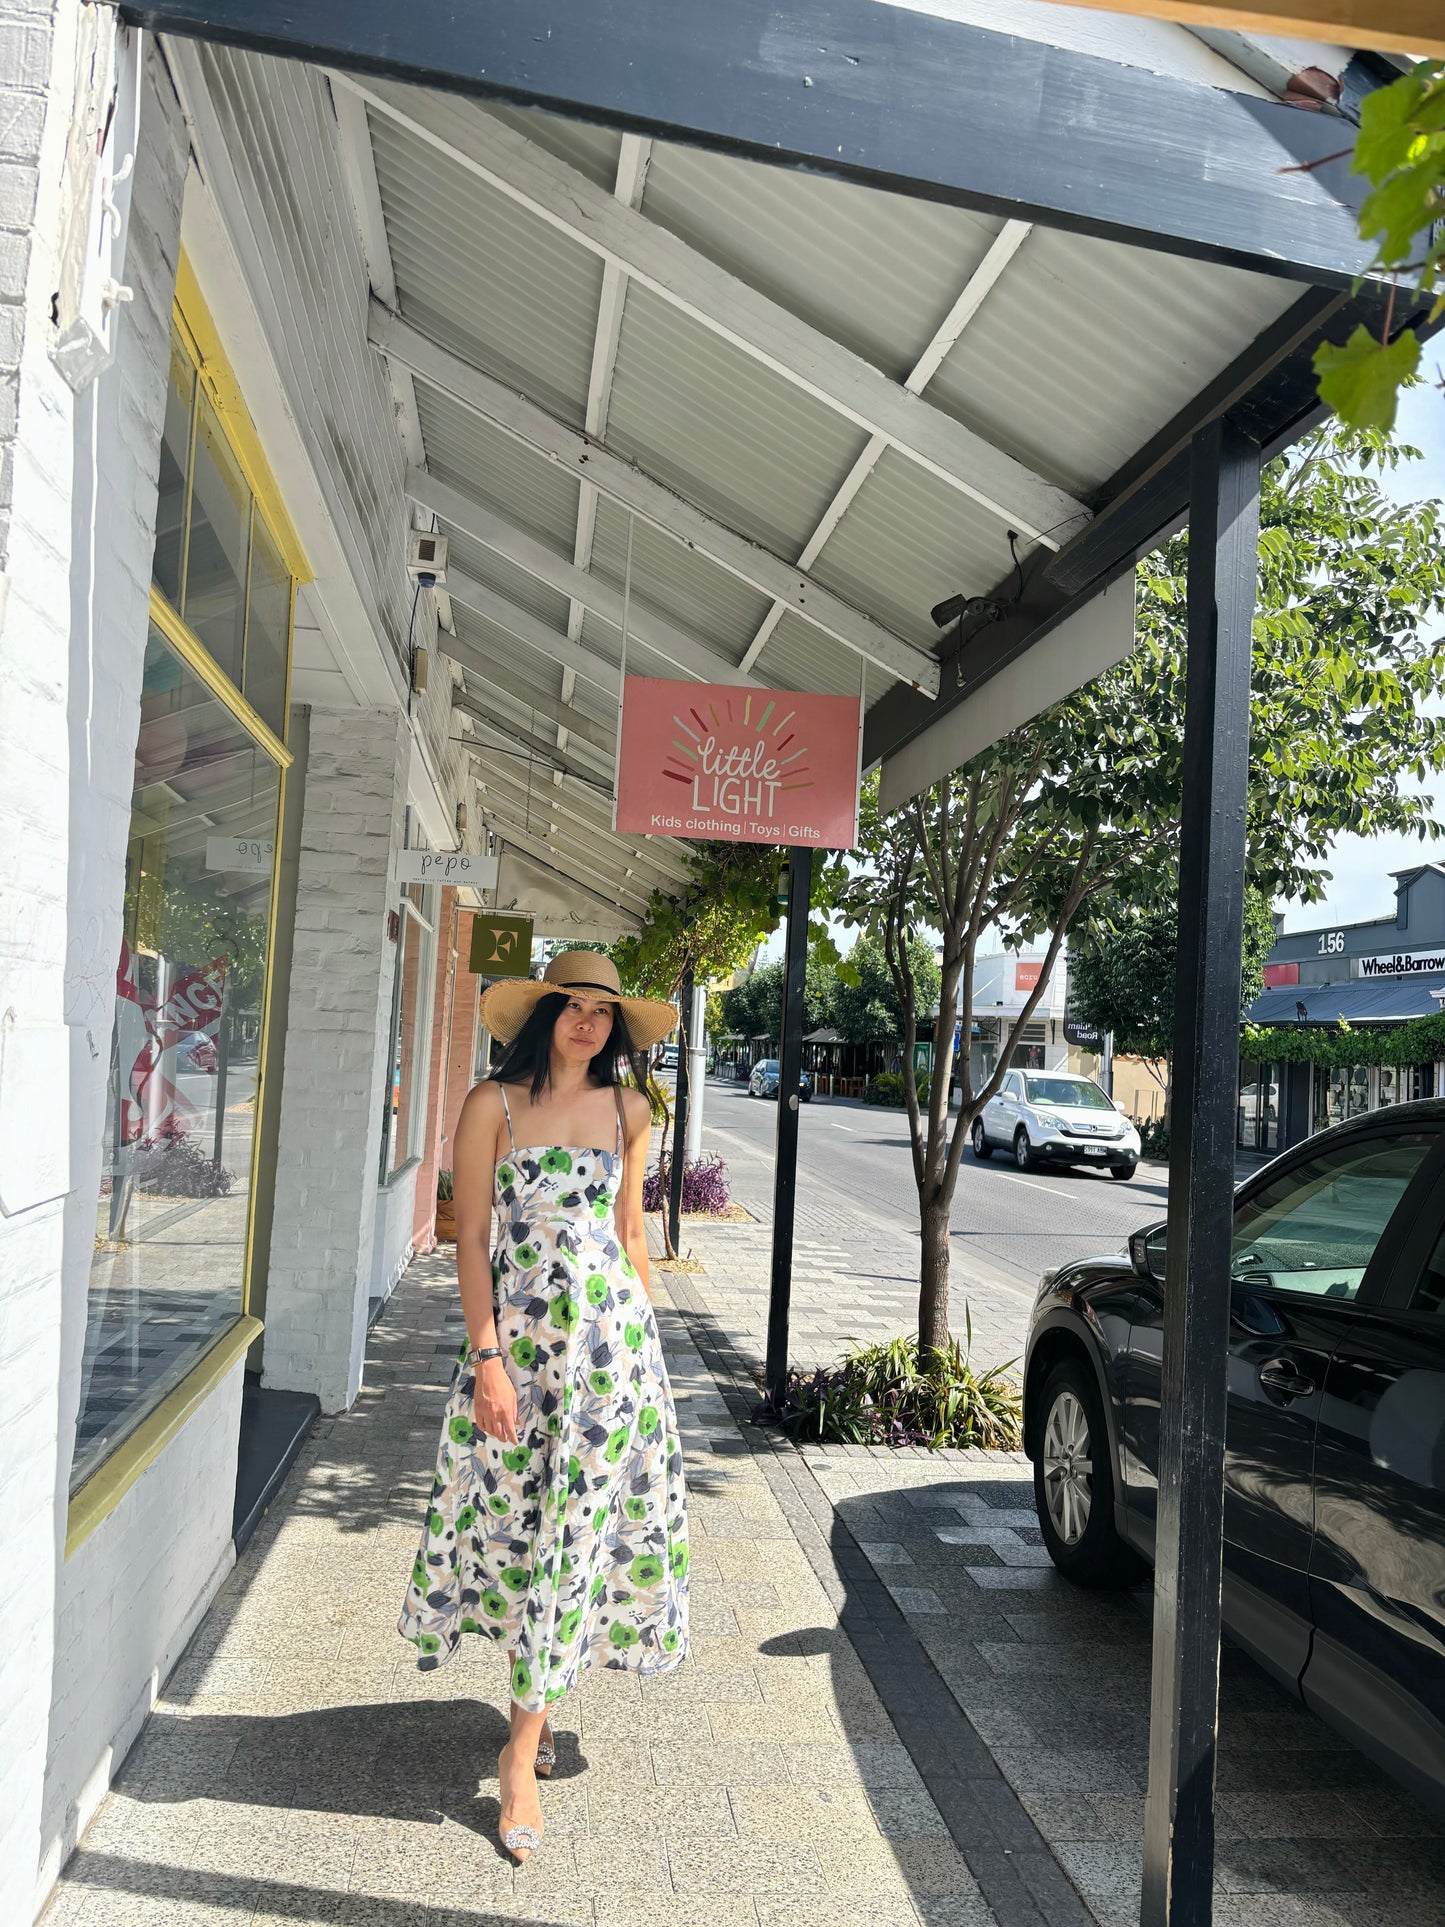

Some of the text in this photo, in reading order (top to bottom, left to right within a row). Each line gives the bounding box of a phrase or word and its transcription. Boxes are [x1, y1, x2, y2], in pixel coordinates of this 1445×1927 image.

[697, 736, 782, 780] little
[691, 774, 783, 818] LIGHT
[651, 814, 821, 839] Kids clothing Toys Gifts
[421, 854, 472, 876] pepo
[485, 928, 519, 963] F
[1318, 931, 1345, 955] 156
[1362, 955, 1445, 976] Wheel&Barrow
